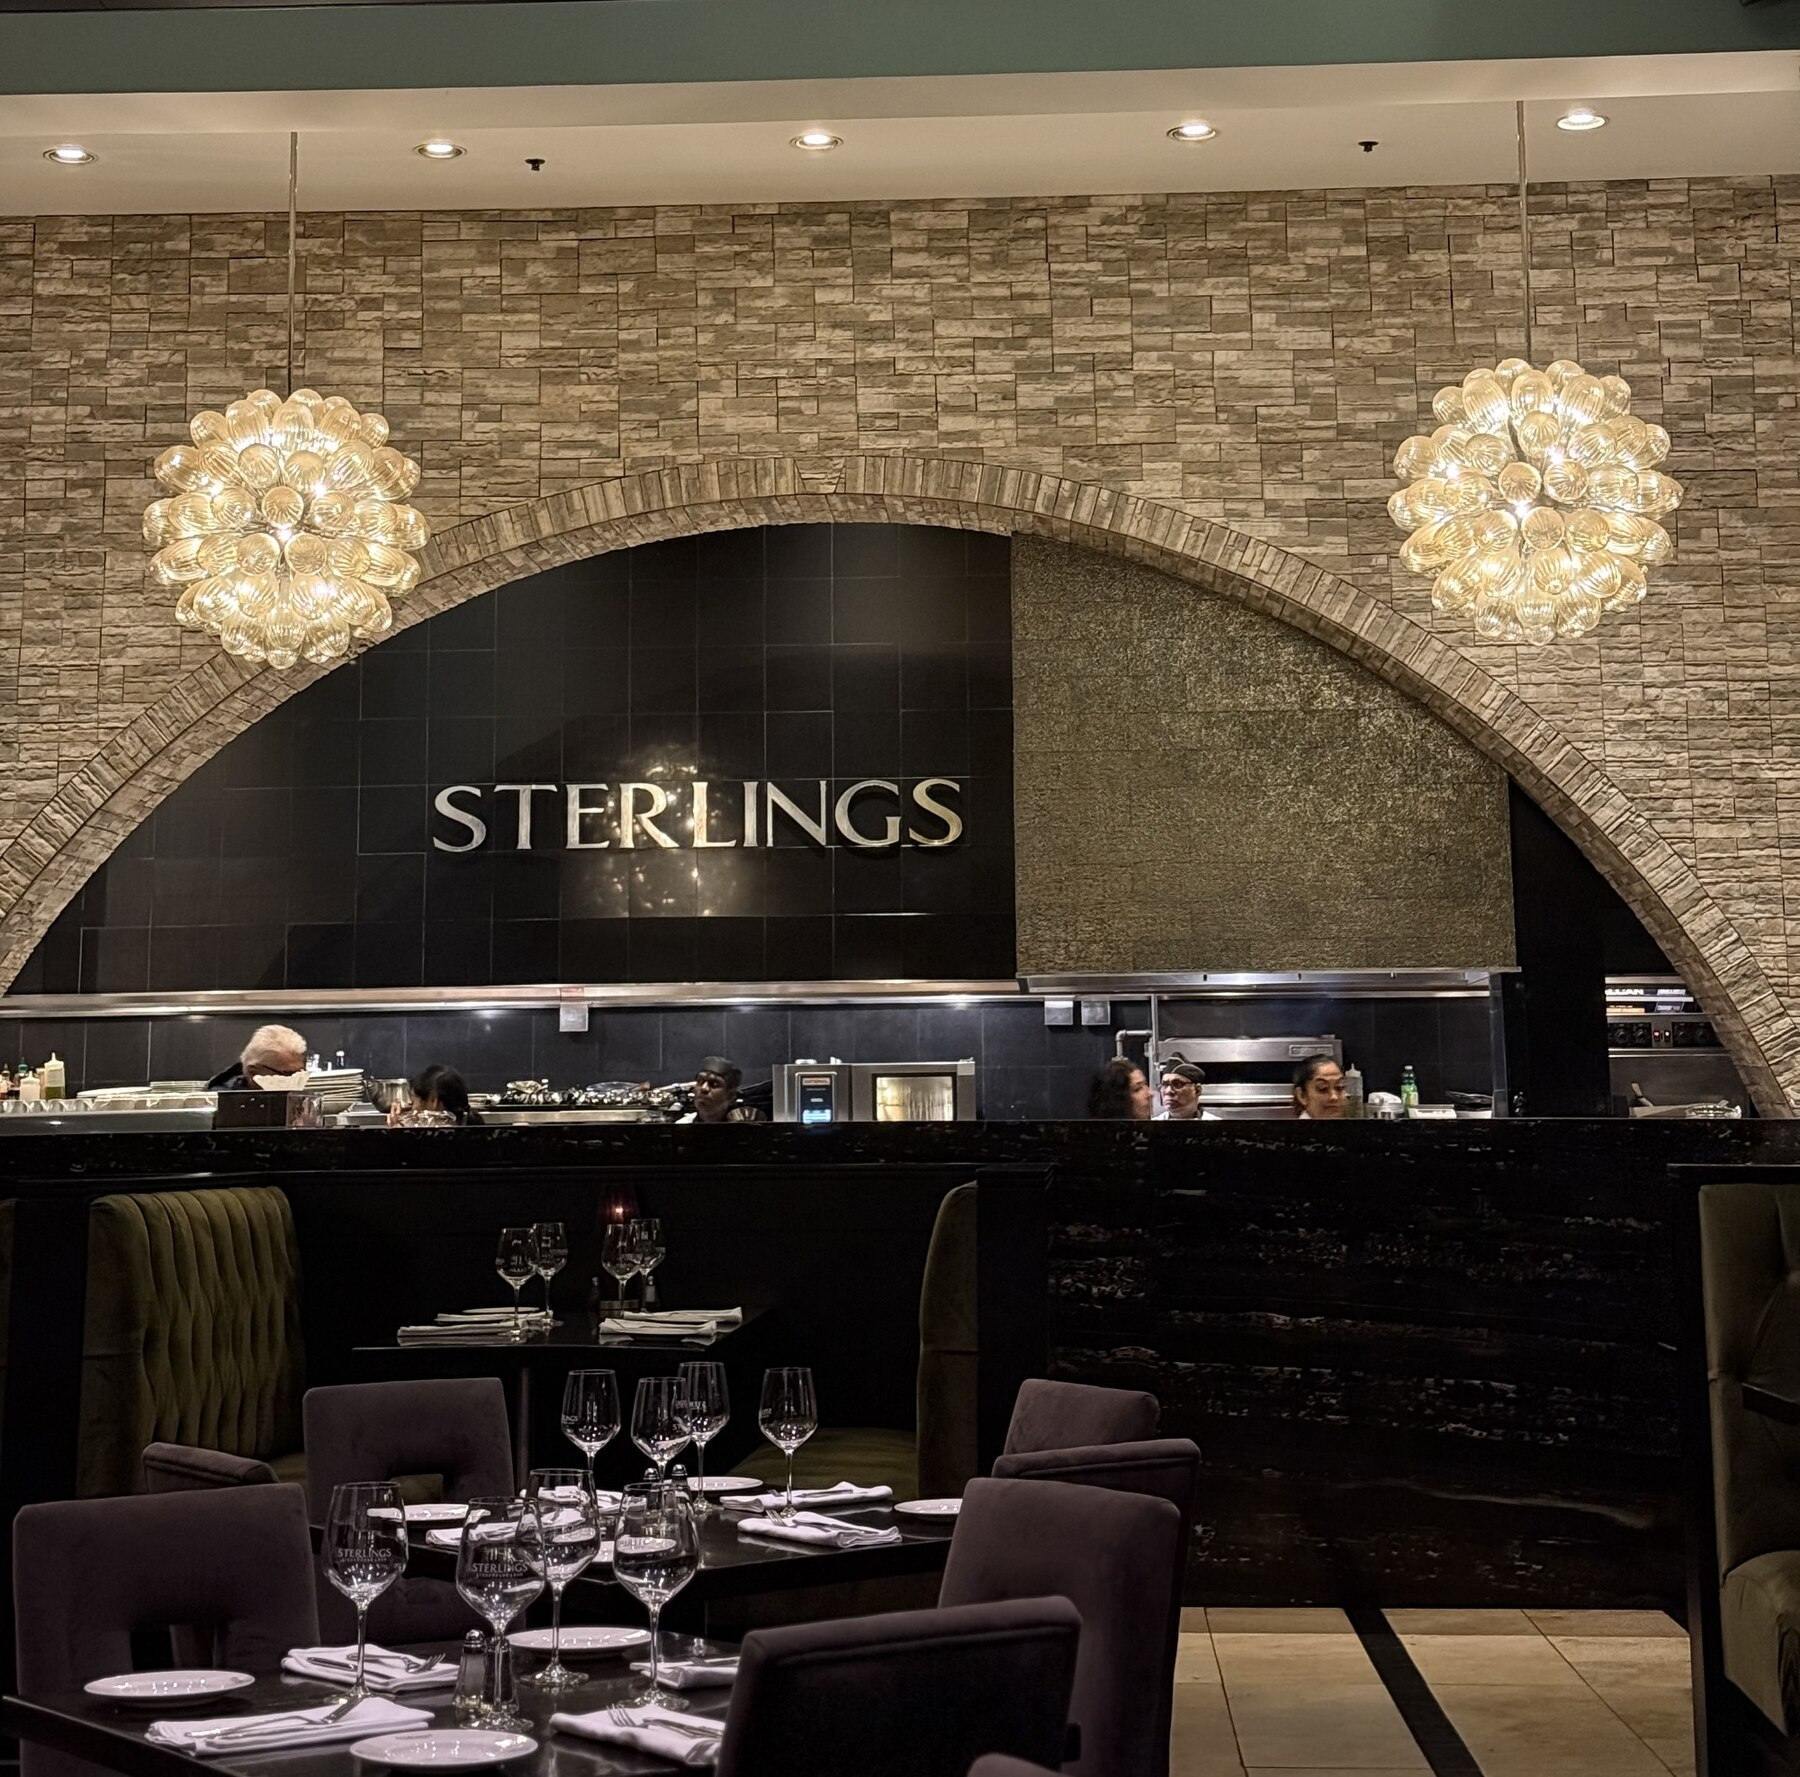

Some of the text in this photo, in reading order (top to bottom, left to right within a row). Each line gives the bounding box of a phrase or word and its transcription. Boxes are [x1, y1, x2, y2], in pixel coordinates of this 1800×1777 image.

[432, 777, 964, 853] STERLINGS
[337, 1548, 392, 1558] STERLINGS
[472, 1562, 528, 1573] STERLINGS
